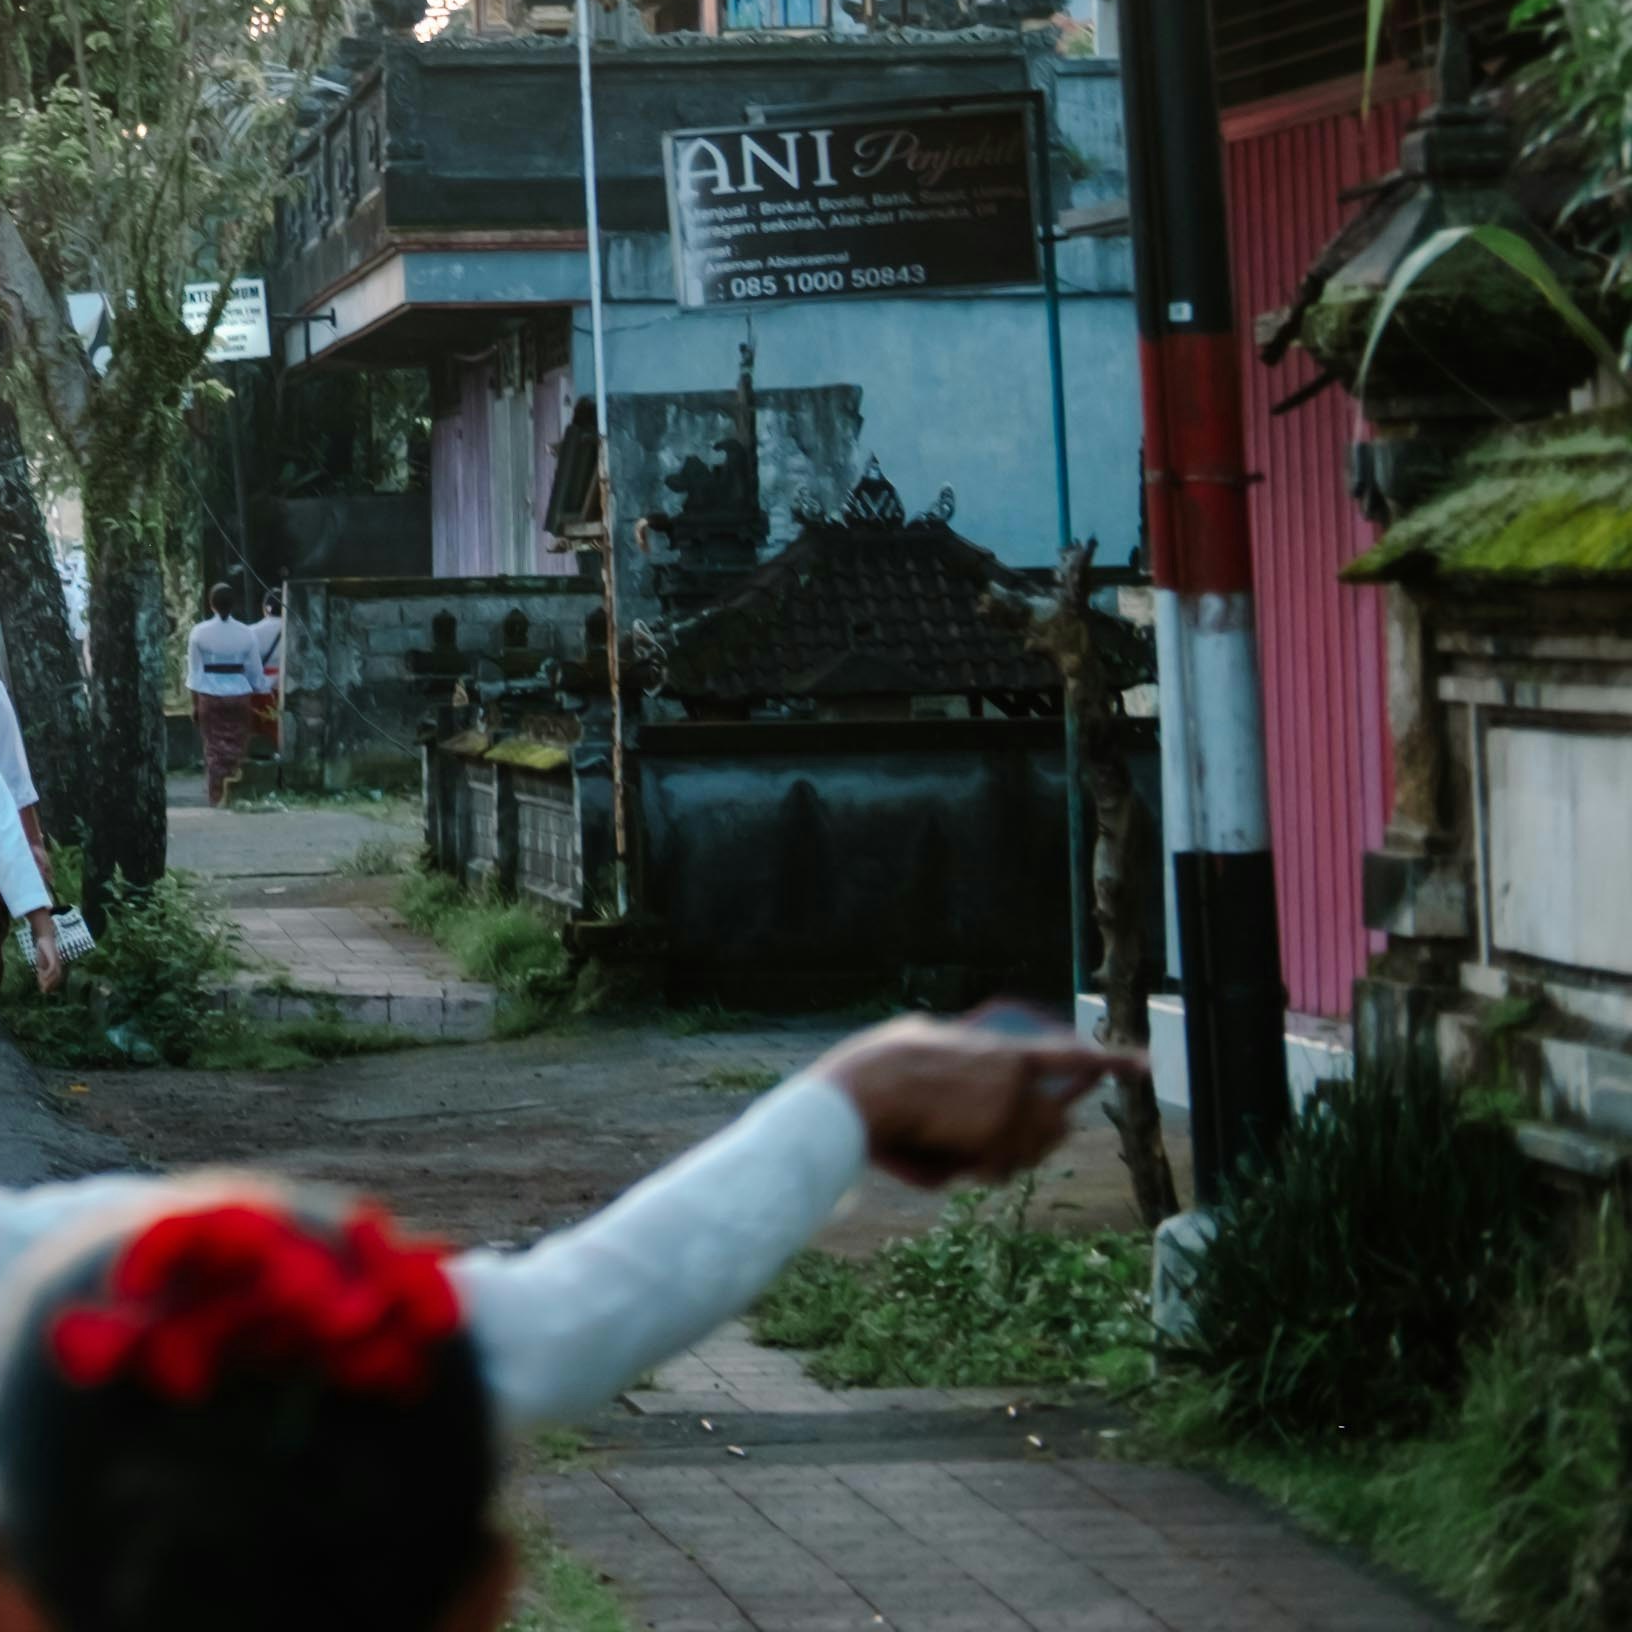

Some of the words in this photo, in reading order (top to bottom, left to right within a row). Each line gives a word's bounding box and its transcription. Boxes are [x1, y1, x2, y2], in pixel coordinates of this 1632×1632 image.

[679, 129, 839, 196] ANI
[689, 202, 748, 222] enjual
[730, 274, 777, 298] 085
[784, 269, 844, 294] 1000
[851, 264, 927, 289] 50843
